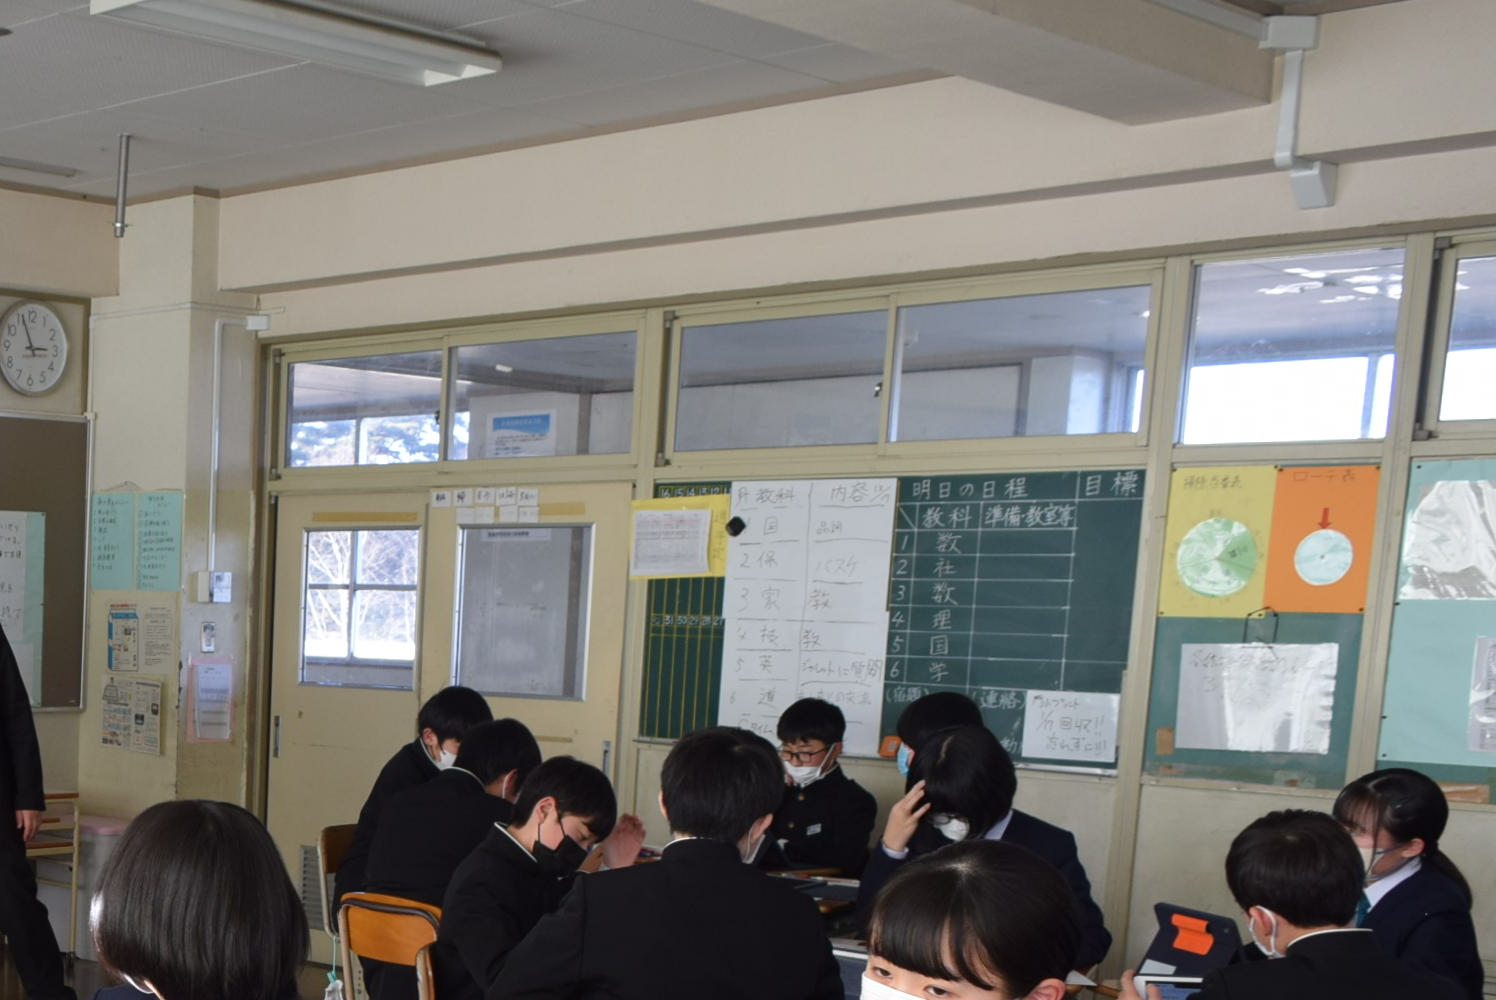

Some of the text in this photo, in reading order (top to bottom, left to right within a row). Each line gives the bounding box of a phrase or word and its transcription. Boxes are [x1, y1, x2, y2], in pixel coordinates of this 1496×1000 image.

[27, 310, 37, 323] 12
[8, 323, 16, 337] 10
[49, 328, 56, 341] 2
[4, 339, 11, 352] 9
[52, 345, 58, 358] 3
[7, 355, 13, 369] 8
[48, 361, 54, 371] 4
[16, 368, 22, 380] 7
[27, 373, 34, 386] 6
[39, 370, 46, 383] 5
[912, 476, 1029, 501] 明日の日程
[1085, 471, 1139, 497] 目標
[661, 489, 671, 498] 16
[675, 488, 683, 497] 15
[687, 487, 695, 496] 14
[710, 487, 720, 495] 12
[922, 505, 973, 529] 教科
[763, 516, 778, 536] 国
[935, 532, 963, 554] 数
[739, 552, 750, 569] 2
[896, 557, 958, 578] 2 社
[896, 581, 960, 607] 3 数
[891, 608, 953, 631] 4 理
[890, 634, 950, 656] 5 国
[889, 661, 950, 683] 6 学
